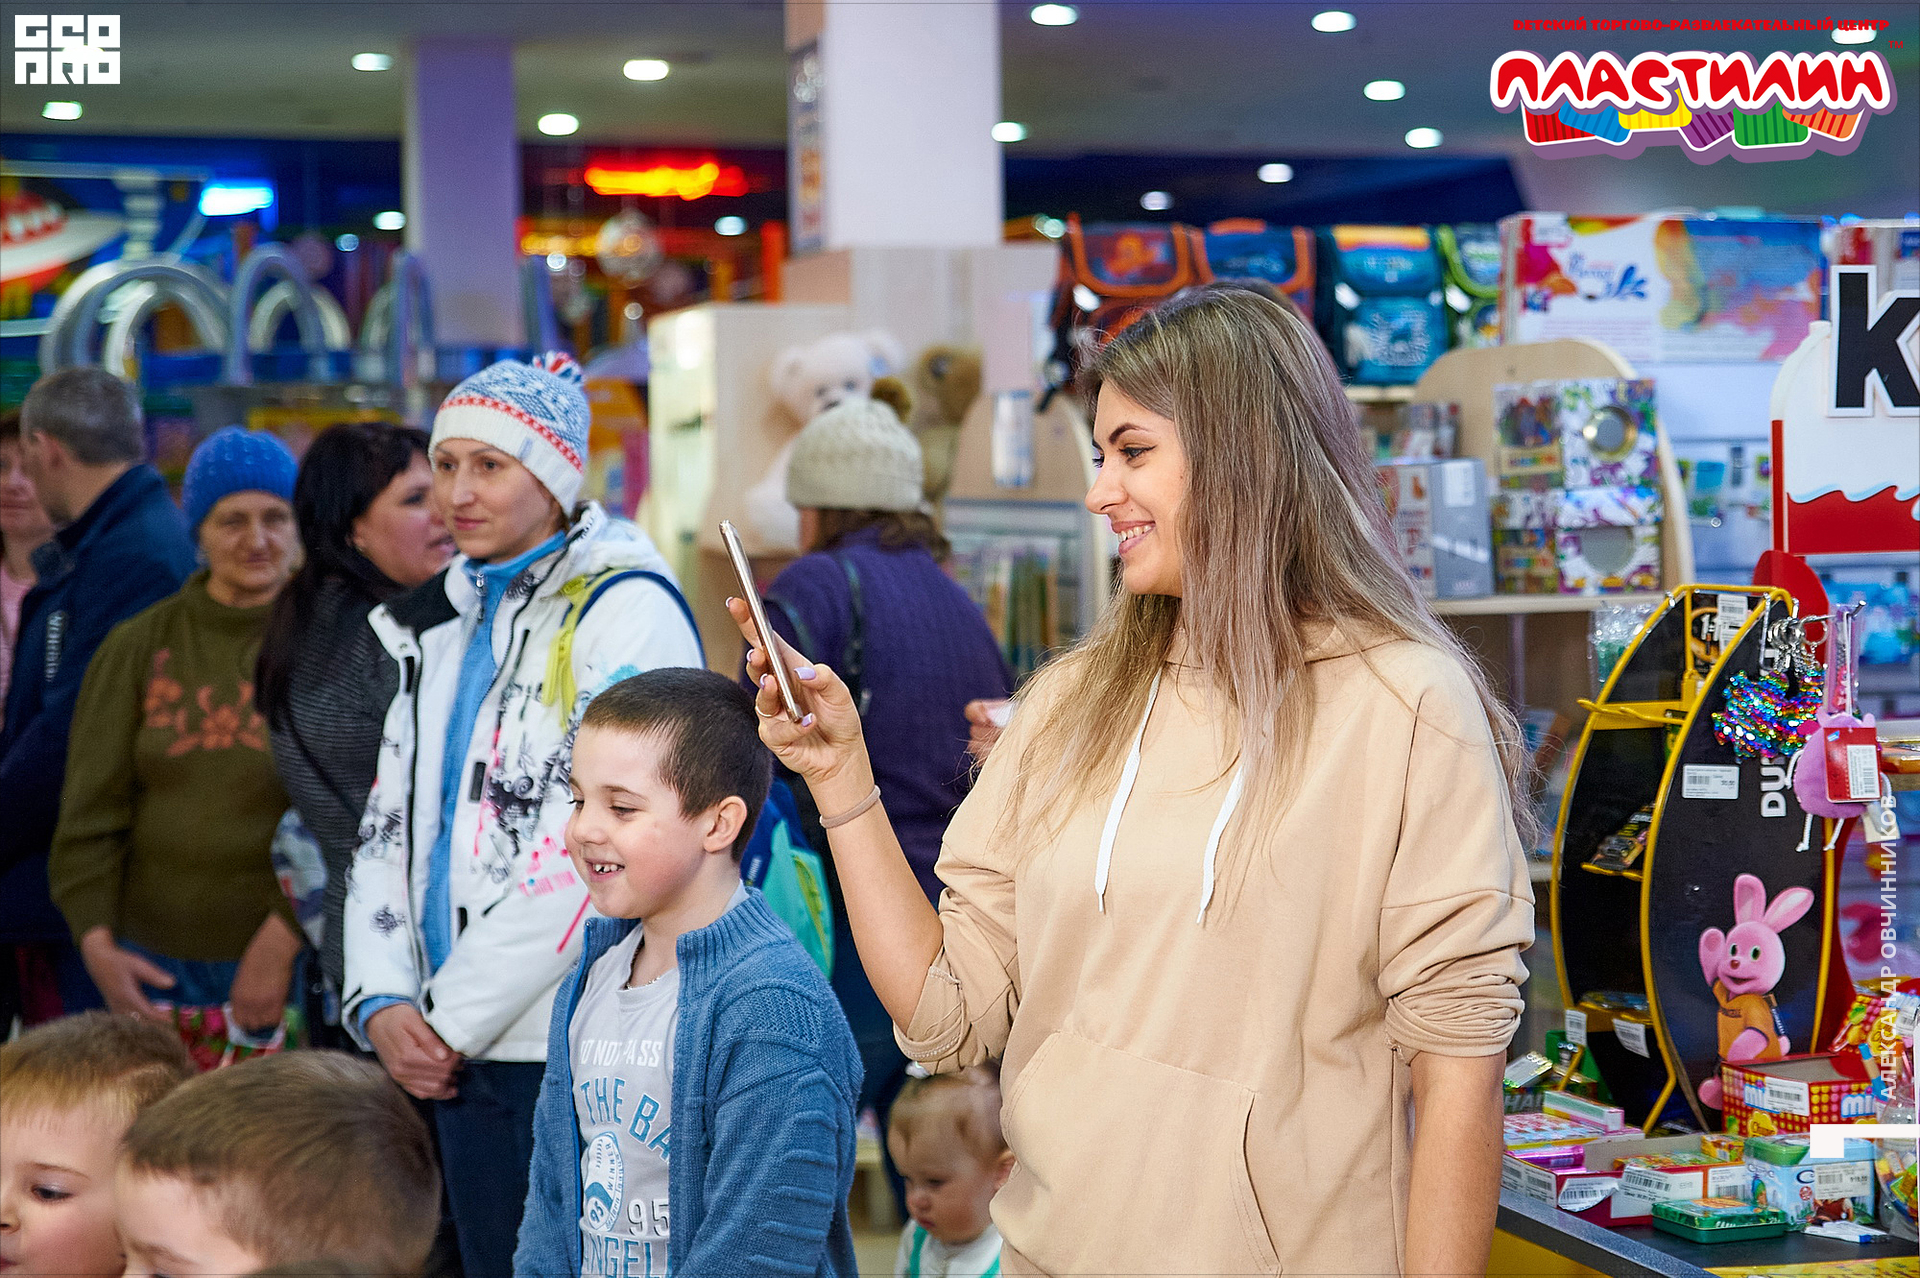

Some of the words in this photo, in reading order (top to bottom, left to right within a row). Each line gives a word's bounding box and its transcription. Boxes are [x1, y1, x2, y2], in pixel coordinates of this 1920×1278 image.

[580, 1076, 626, 1126] THE
[628, 1093, 671, 1163] BA
[590, 1200, 604, 1223] 95
[627, 1198, 670, 1238] 95
[583, 1232, 673, 1278] ANGEL
